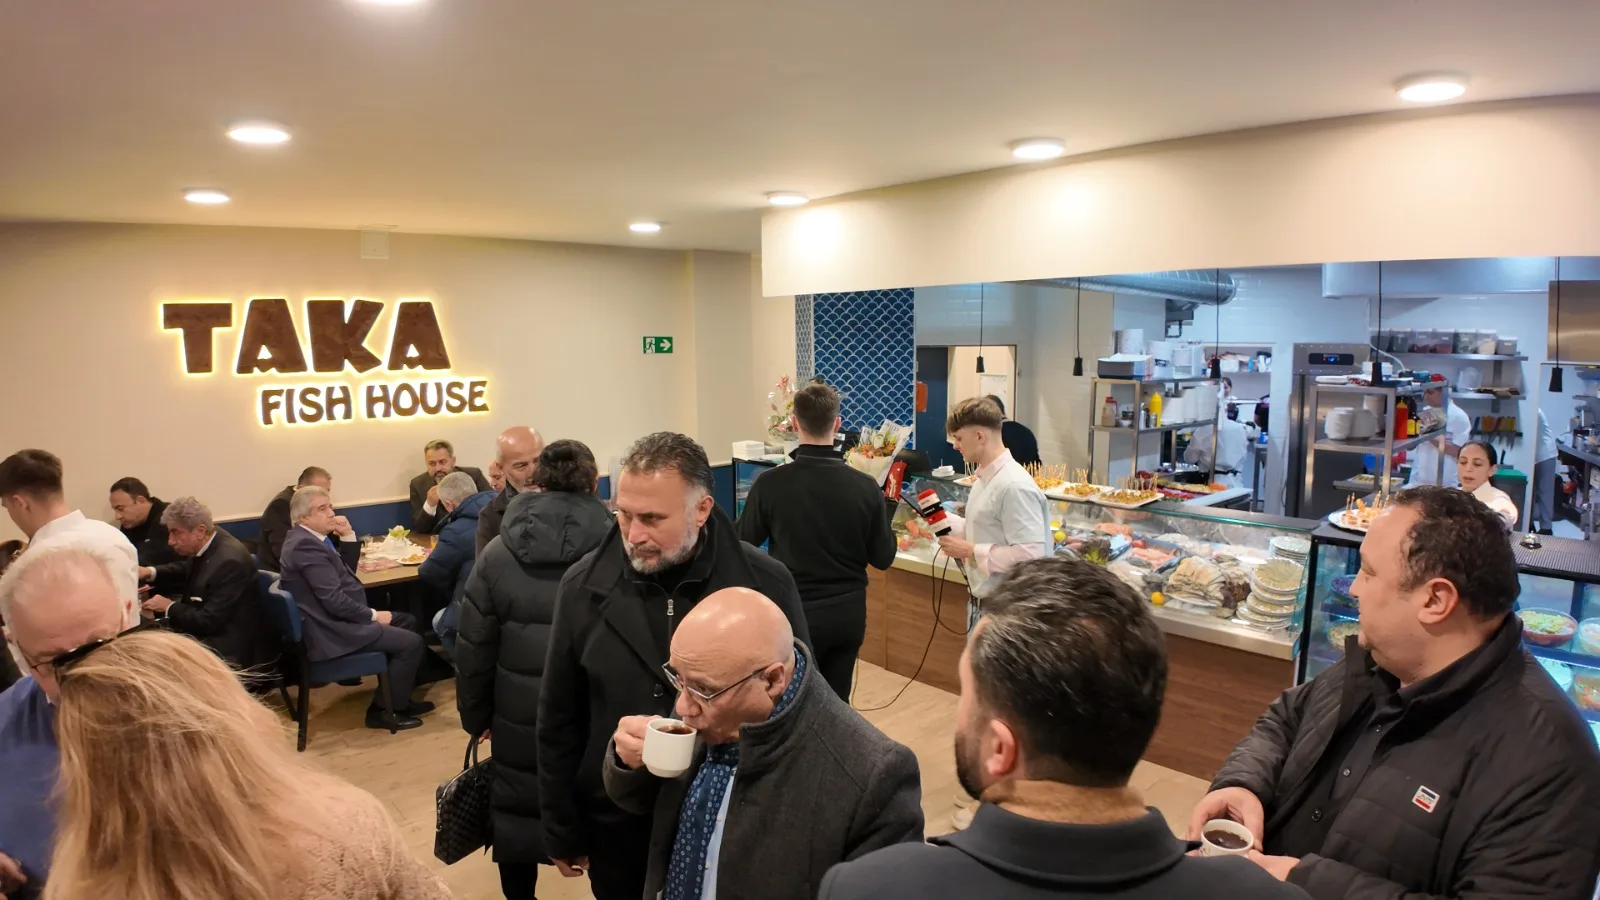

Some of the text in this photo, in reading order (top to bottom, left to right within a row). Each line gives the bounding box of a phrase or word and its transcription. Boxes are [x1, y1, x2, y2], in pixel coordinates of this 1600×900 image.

[163, 299, 451, 374] TAKA
[261, 381, 489, 425] FISH HOUSE
